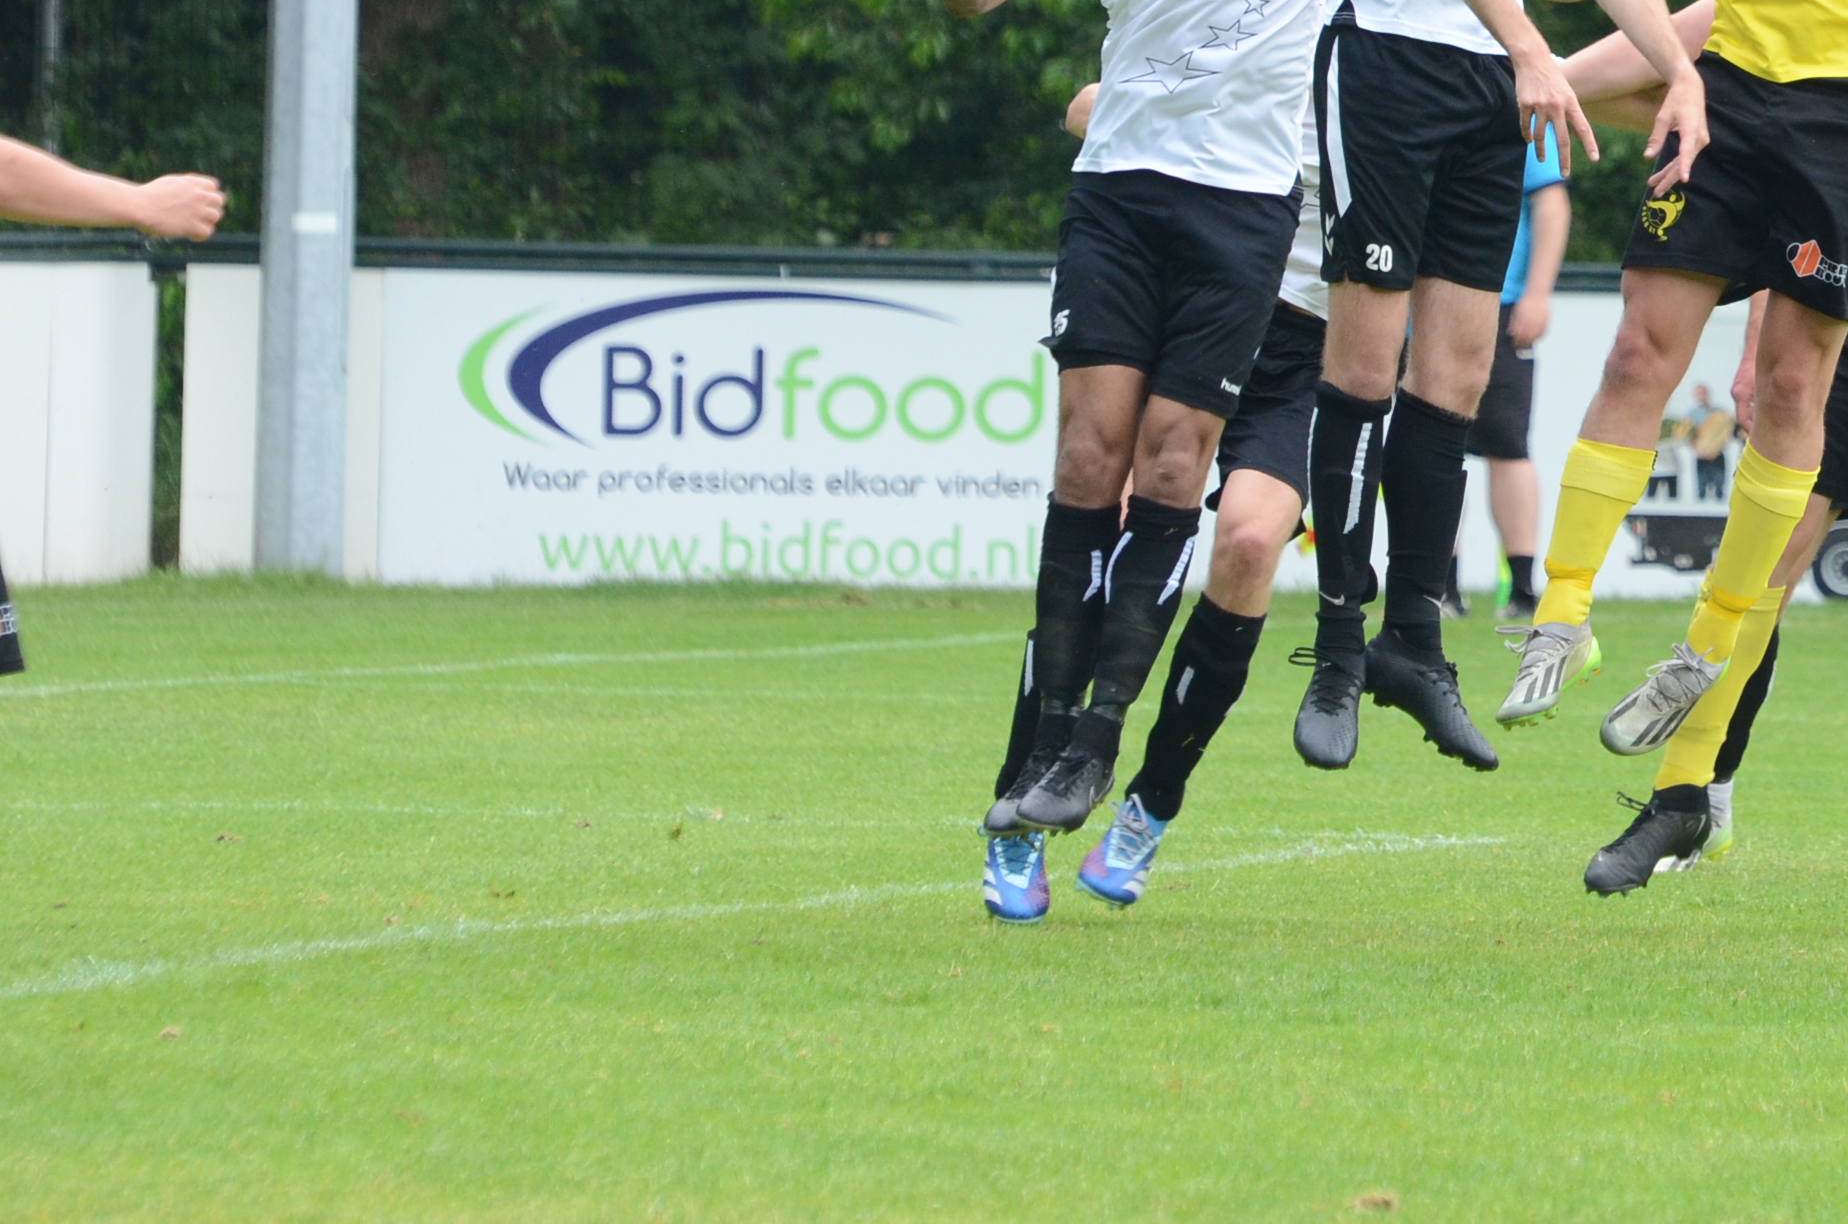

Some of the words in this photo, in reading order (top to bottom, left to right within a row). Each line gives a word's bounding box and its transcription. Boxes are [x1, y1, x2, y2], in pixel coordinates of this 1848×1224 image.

[1365, 243, 1393, 273] 20
[602, 345, 1046, 444] Bidfood
[503, 461, 588, 492] Waar
[597, 462, 814, 499] professionals
[825, 467, 924, 498] elkaar
[936, 472, 1041, 499] vinden
[537, 517, 1041, 580] www.bidfood.nl
